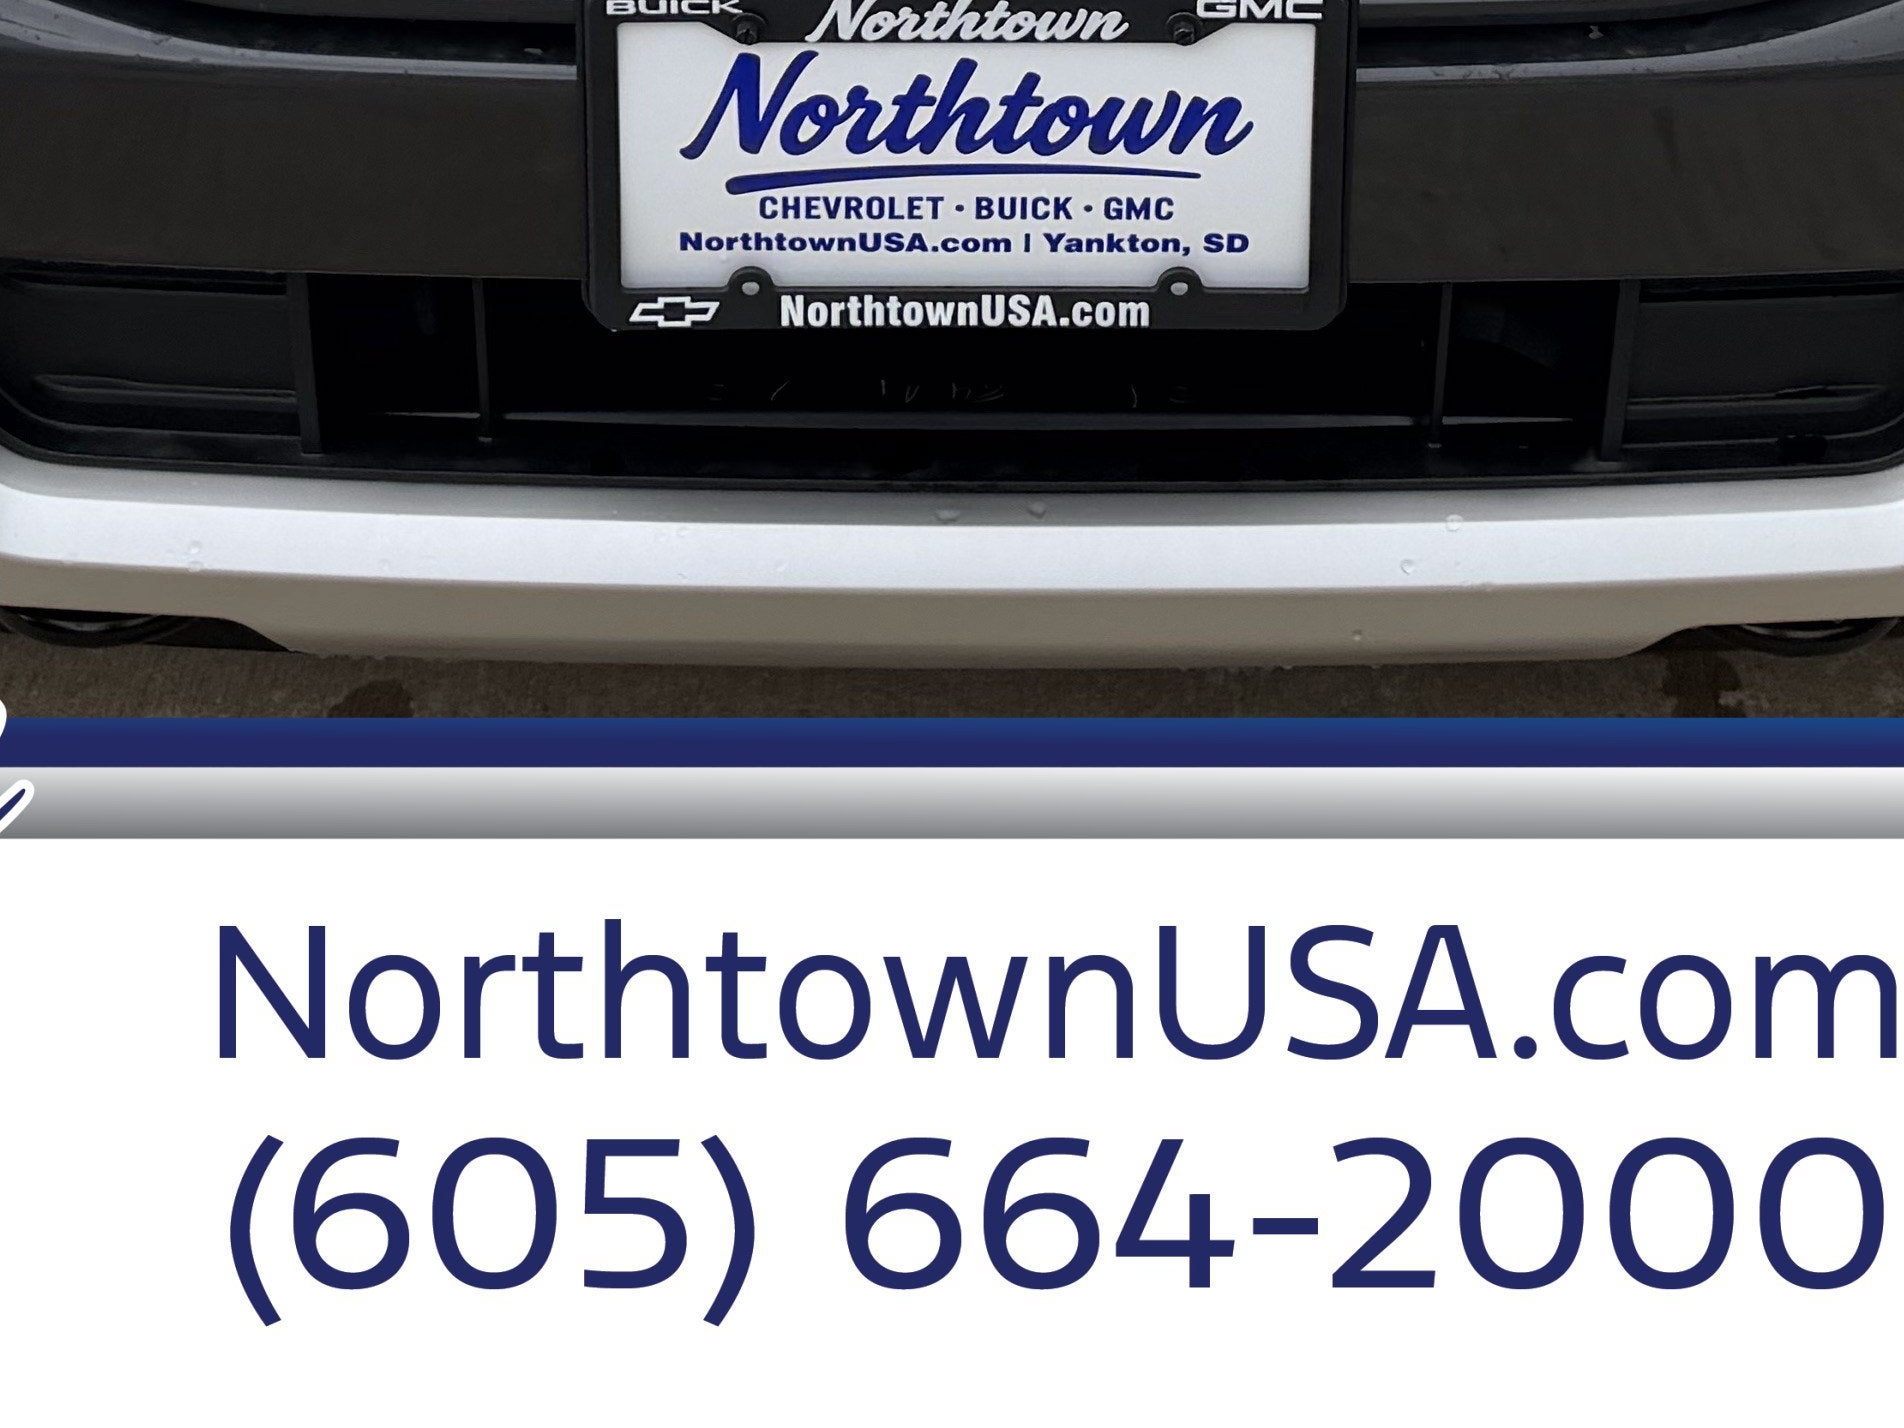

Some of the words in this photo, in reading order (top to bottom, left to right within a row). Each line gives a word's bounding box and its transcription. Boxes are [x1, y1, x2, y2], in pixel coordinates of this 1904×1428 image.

[679, 49, 1254, 160] Northtown
[757, 195, 944, 221] CHEVROLET
[974, 196, 1073, 221] BUICK
[1103, 196, 1175, 221] GMC
[678, 231, 1012, 254] NorthtownUSA.com
[1042, 232, 1191, 257] Yankton,
[1202, 232, 1251, 254] SD
[779, 293, 1151, 328] NorthtownUSA.com
